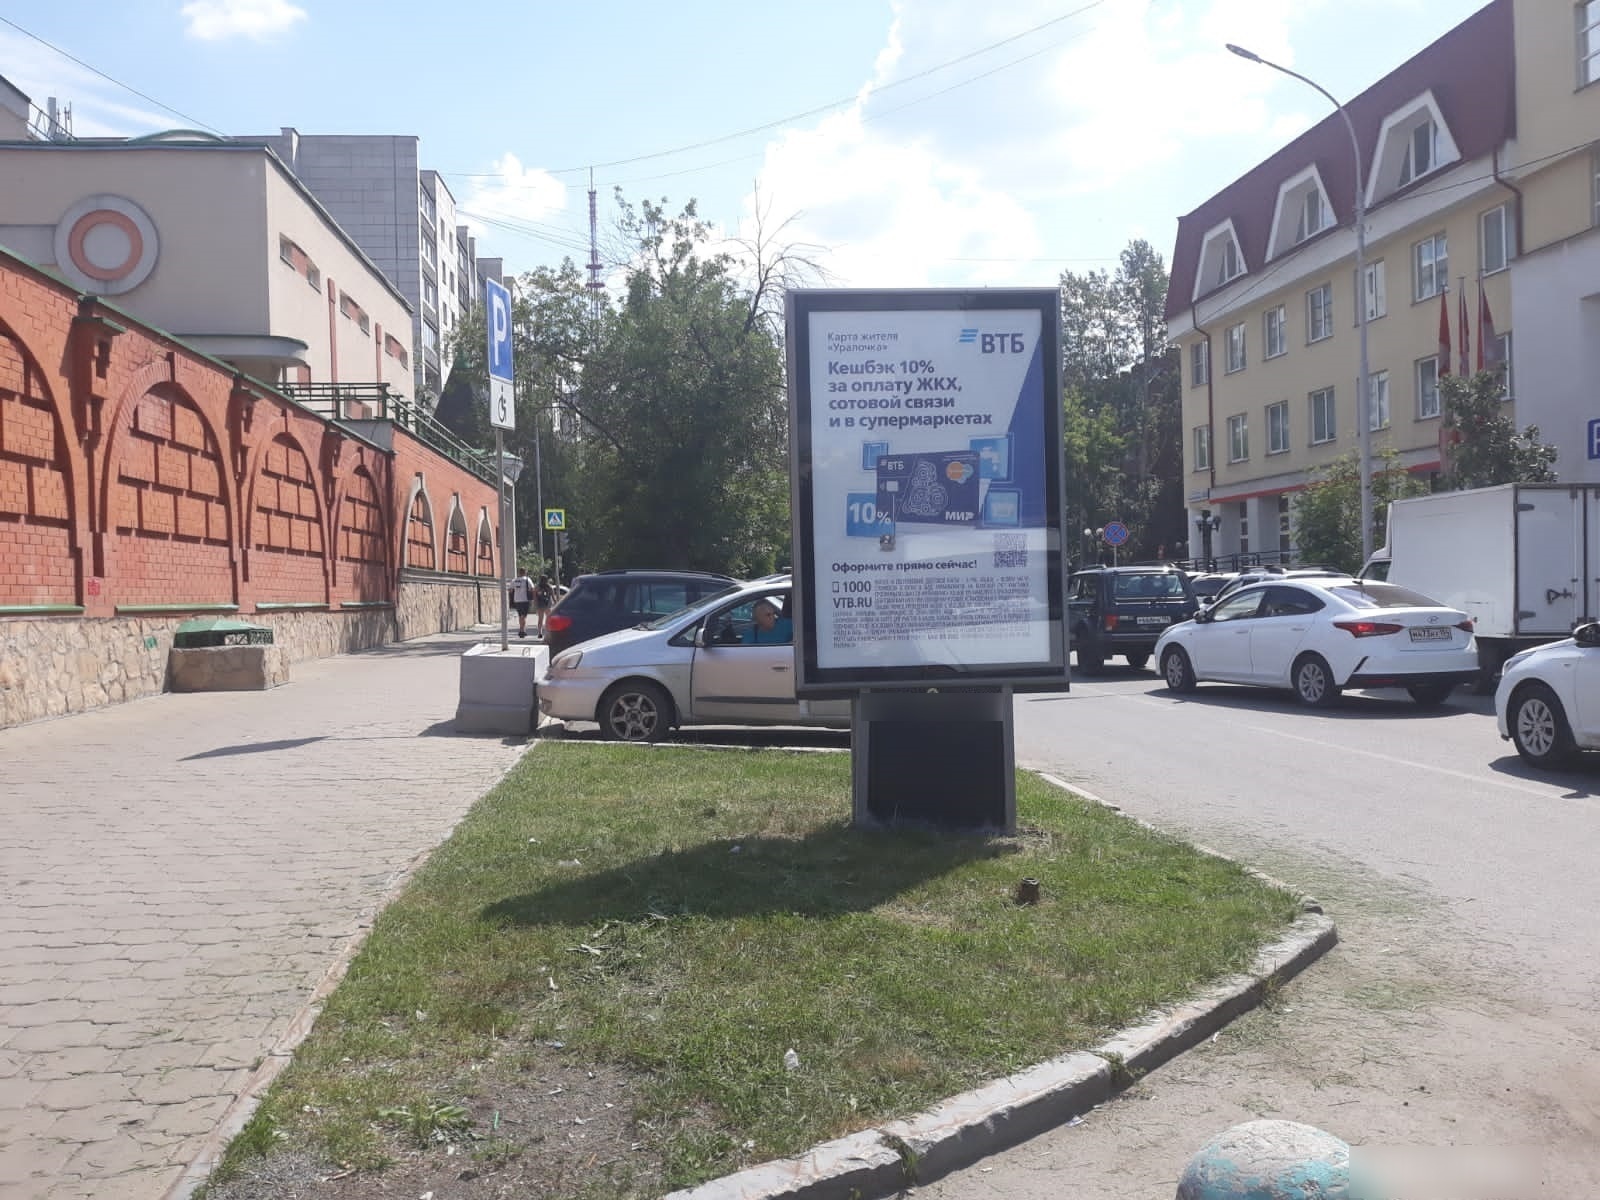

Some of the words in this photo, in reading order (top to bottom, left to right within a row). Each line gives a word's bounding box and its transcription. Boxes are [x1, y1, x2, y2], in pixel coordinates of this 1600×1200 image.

[493, 293, 507, 366] P
[827, 332, 858, 344] Карта
[860, 331, 898, 342] жителя
[981, 333, 1025, 354] ВТБ
[827, 342, 888, 353] «Уралочка»
[828, 360, 895, 375] Кешбэк
[900, 360, 935, 374] 10%
[828, 381, 848, 393] за
[851, 381, 913, 395] оплату
[916, 377, 962, 393] ЖКХ,
[829, 395, 901, 410] сотовой
[905, 396, 955, 409] связи
[829, 416, 841, 428] и
[845, 416, 855, 427] в
[860, 413, 992, 431] супермаркетах
[849, 502, 891, 525] 10%
[944, 510, 975, 522] МИР
[832, 561, 893, 574] Оформите
[896, 562, 933, 572] прямо
[935, 559, 977, 570] сейчас!
[843, 581, 871, 593] 1000
[833, 597, 872, 609] VTB.RU
